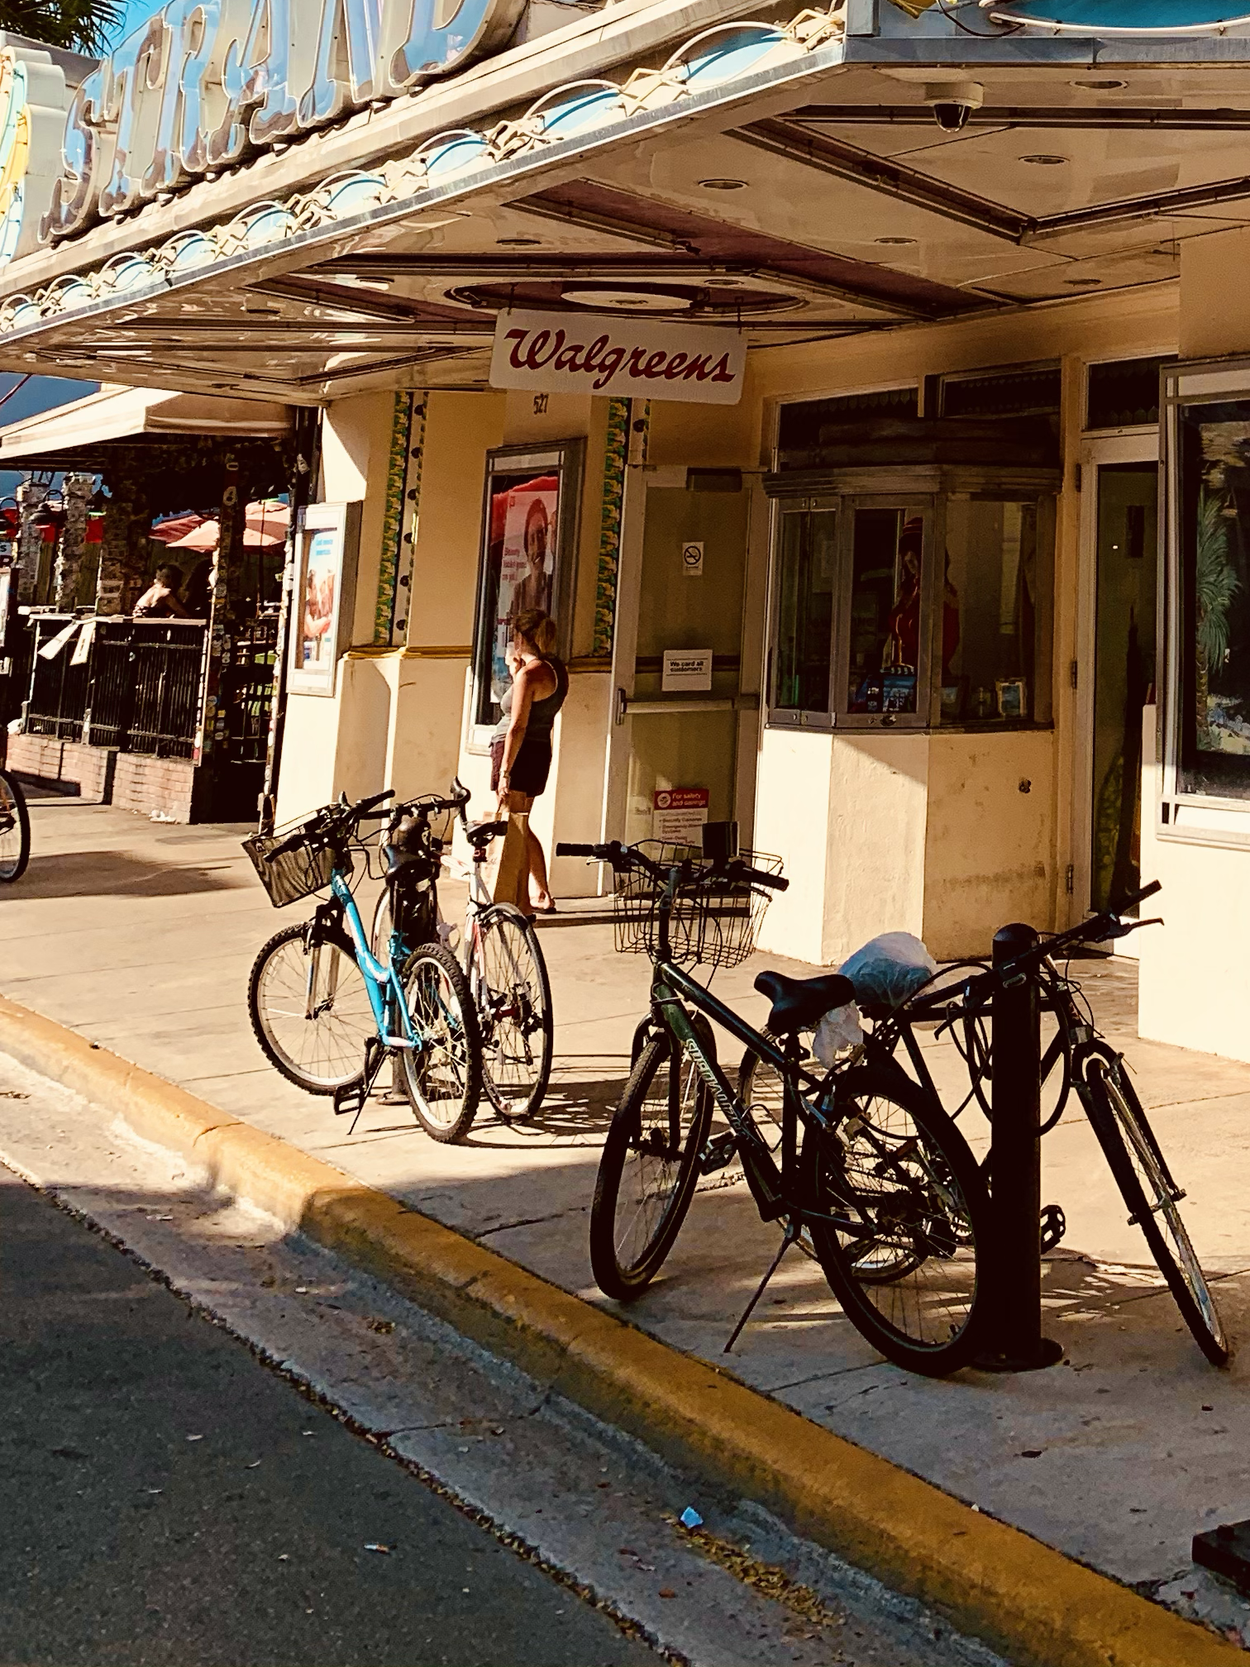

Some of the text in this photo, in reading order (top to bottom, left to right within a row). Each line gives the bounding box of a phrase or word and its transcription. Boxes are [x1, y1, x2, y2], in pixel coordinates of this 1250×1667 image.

[503, 328, 737, 390] Walgreens
[533, 393, 549, 415] 527
[670, 660, 680, 668] We
